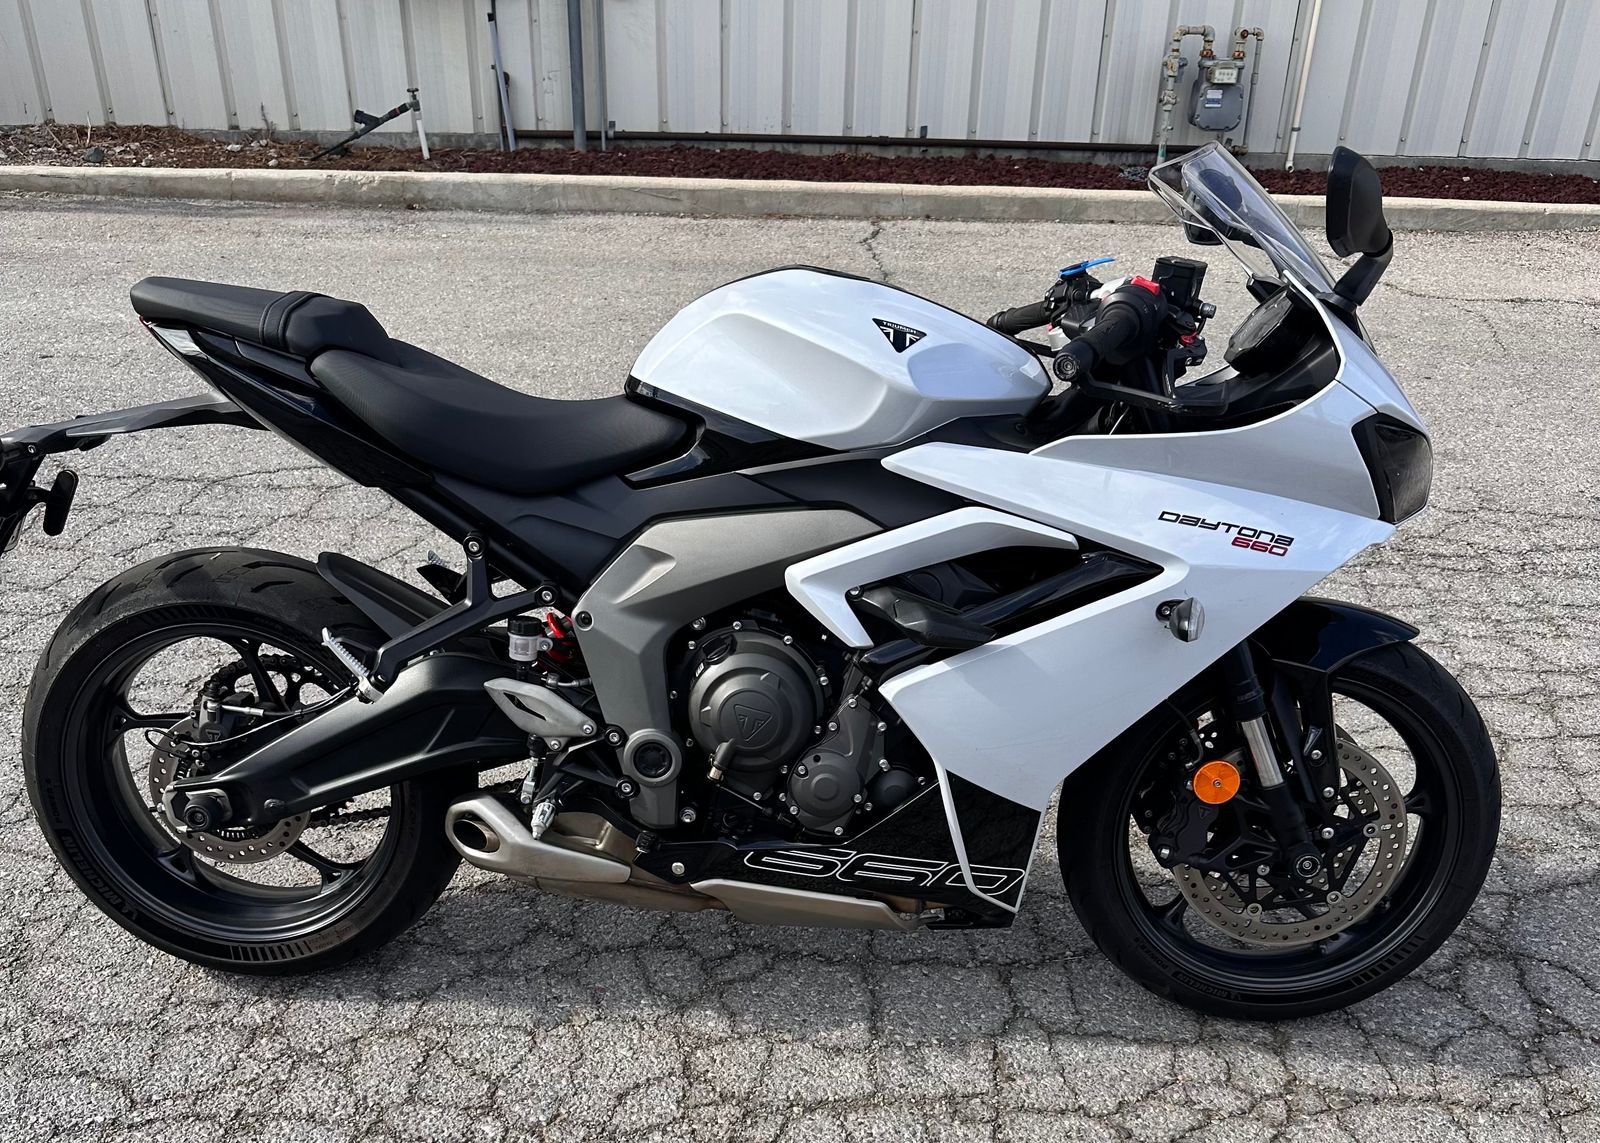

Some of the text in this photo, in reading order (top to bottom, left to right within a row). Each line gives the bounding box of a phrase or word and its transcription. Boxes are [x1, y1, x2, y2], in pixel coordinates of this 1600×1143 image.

[1231, 536, 1288, 556] 660
[59, 831, 124, 905] MICHELIN
[744, 849, 1025, 896] 660
[1176, 972, 1229, 997] MICHELIN
